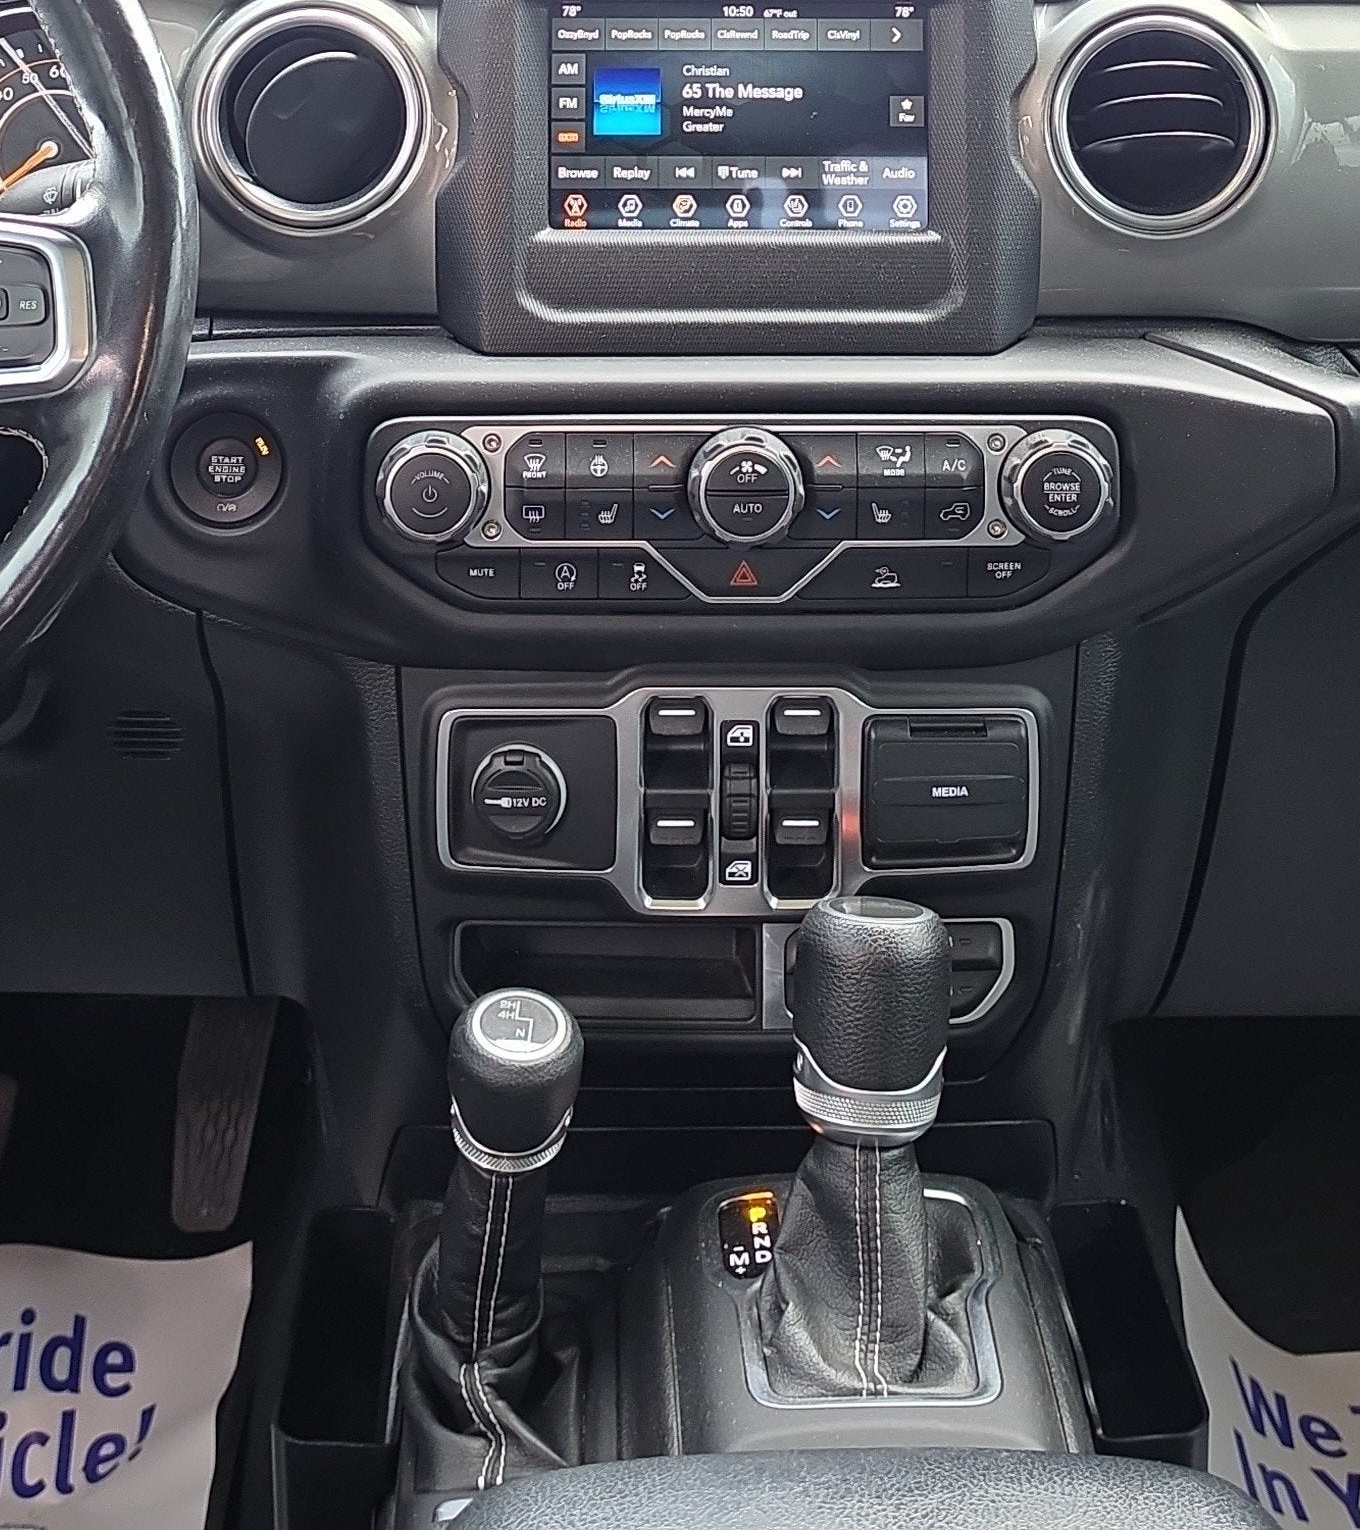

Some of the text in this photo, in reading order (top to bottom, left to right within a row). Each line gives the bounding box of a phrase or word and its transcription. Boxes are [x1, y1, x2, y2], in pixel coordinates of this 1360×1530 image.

[722, 5, 754, 17] 10:50
[611, 29, 652, 40] PopRocks
[664, 29, 705, 40] PopRocks
[772, 30, 810, 41] RoadTrip
[558, 63, 579, 75] AM
[682, 64, 730, 77] Christian
[681, 83, 804, 102] 65 The Message
[558, 97, 578, 109] FM
[682, 105, 734, 119] MercyMe
[898, 113, 915, 123] Fav
[682, 120, 725, 133] Greater
[822, 159, 869, 172] Traffic &
[557, 166, 599, 179] Browse
[613, 166, 651, 181] Replay
[730, 166, 759, 178] Tune
[882, 167, 916, 179] Audio
[822, 173, 869, 186] Weather
[564, 219, 588, 228] Radio
[618, 219, 643, 228] Media
[669, 219, 701, 228] Climate
[727, 219, 749, 229] Apps
[779, 219, 813, 228] Controls
[837, 219, 864, 228] Phone
[889, 219, 921, 229] Settings
[19, 300, 37, 310] RES
[211, 455, 244, 464] START
[942, 458, 968, 472] A/C
[208, 465, 246, 473] ENGINE
[522, 470, 547, 479] FRONT
[883, 468, 906, 477] MODE
[1051, 467, 1073, 476] TUNE
[214, 475, 242, 483] STOP
[414, 471, 446, 481] VOLUME
[736, 473, 758, 484] OFF
[1043, 482, 1081, 491] BROWSE
[1048, 494, 1078, 503] ENTER
[732, 503, 762, 514] AUTO
[1048, 505, 1079, 517] SCROLL
[987, 562, 1022, 571] SCREEN
[469, 568, 495, 577] MUTE
[995, 571, 1013, 579] OFF
[557, 581, 575, 591] OFF
[630, 582, 648, 591] OFF
[931, 786, 969, 798] MEDIA
[512, 797, 547, 807] 12V DC
[499, 1000, 516, 1010] 2H
[497, 1010, 515, 1020] 4H
[515, 1028, 526, 1038] N
[749, 1207, 766, 1223] P
[751, 1222, 768, 1235] R
[753, 1235, 771, 1249] N
[729, 1252, 750, 1267] M
[755, 1250, 773, 1264] D
[1228, 1354, 1348, 1460] We
[1233, 1427, 1310, 1524] In
